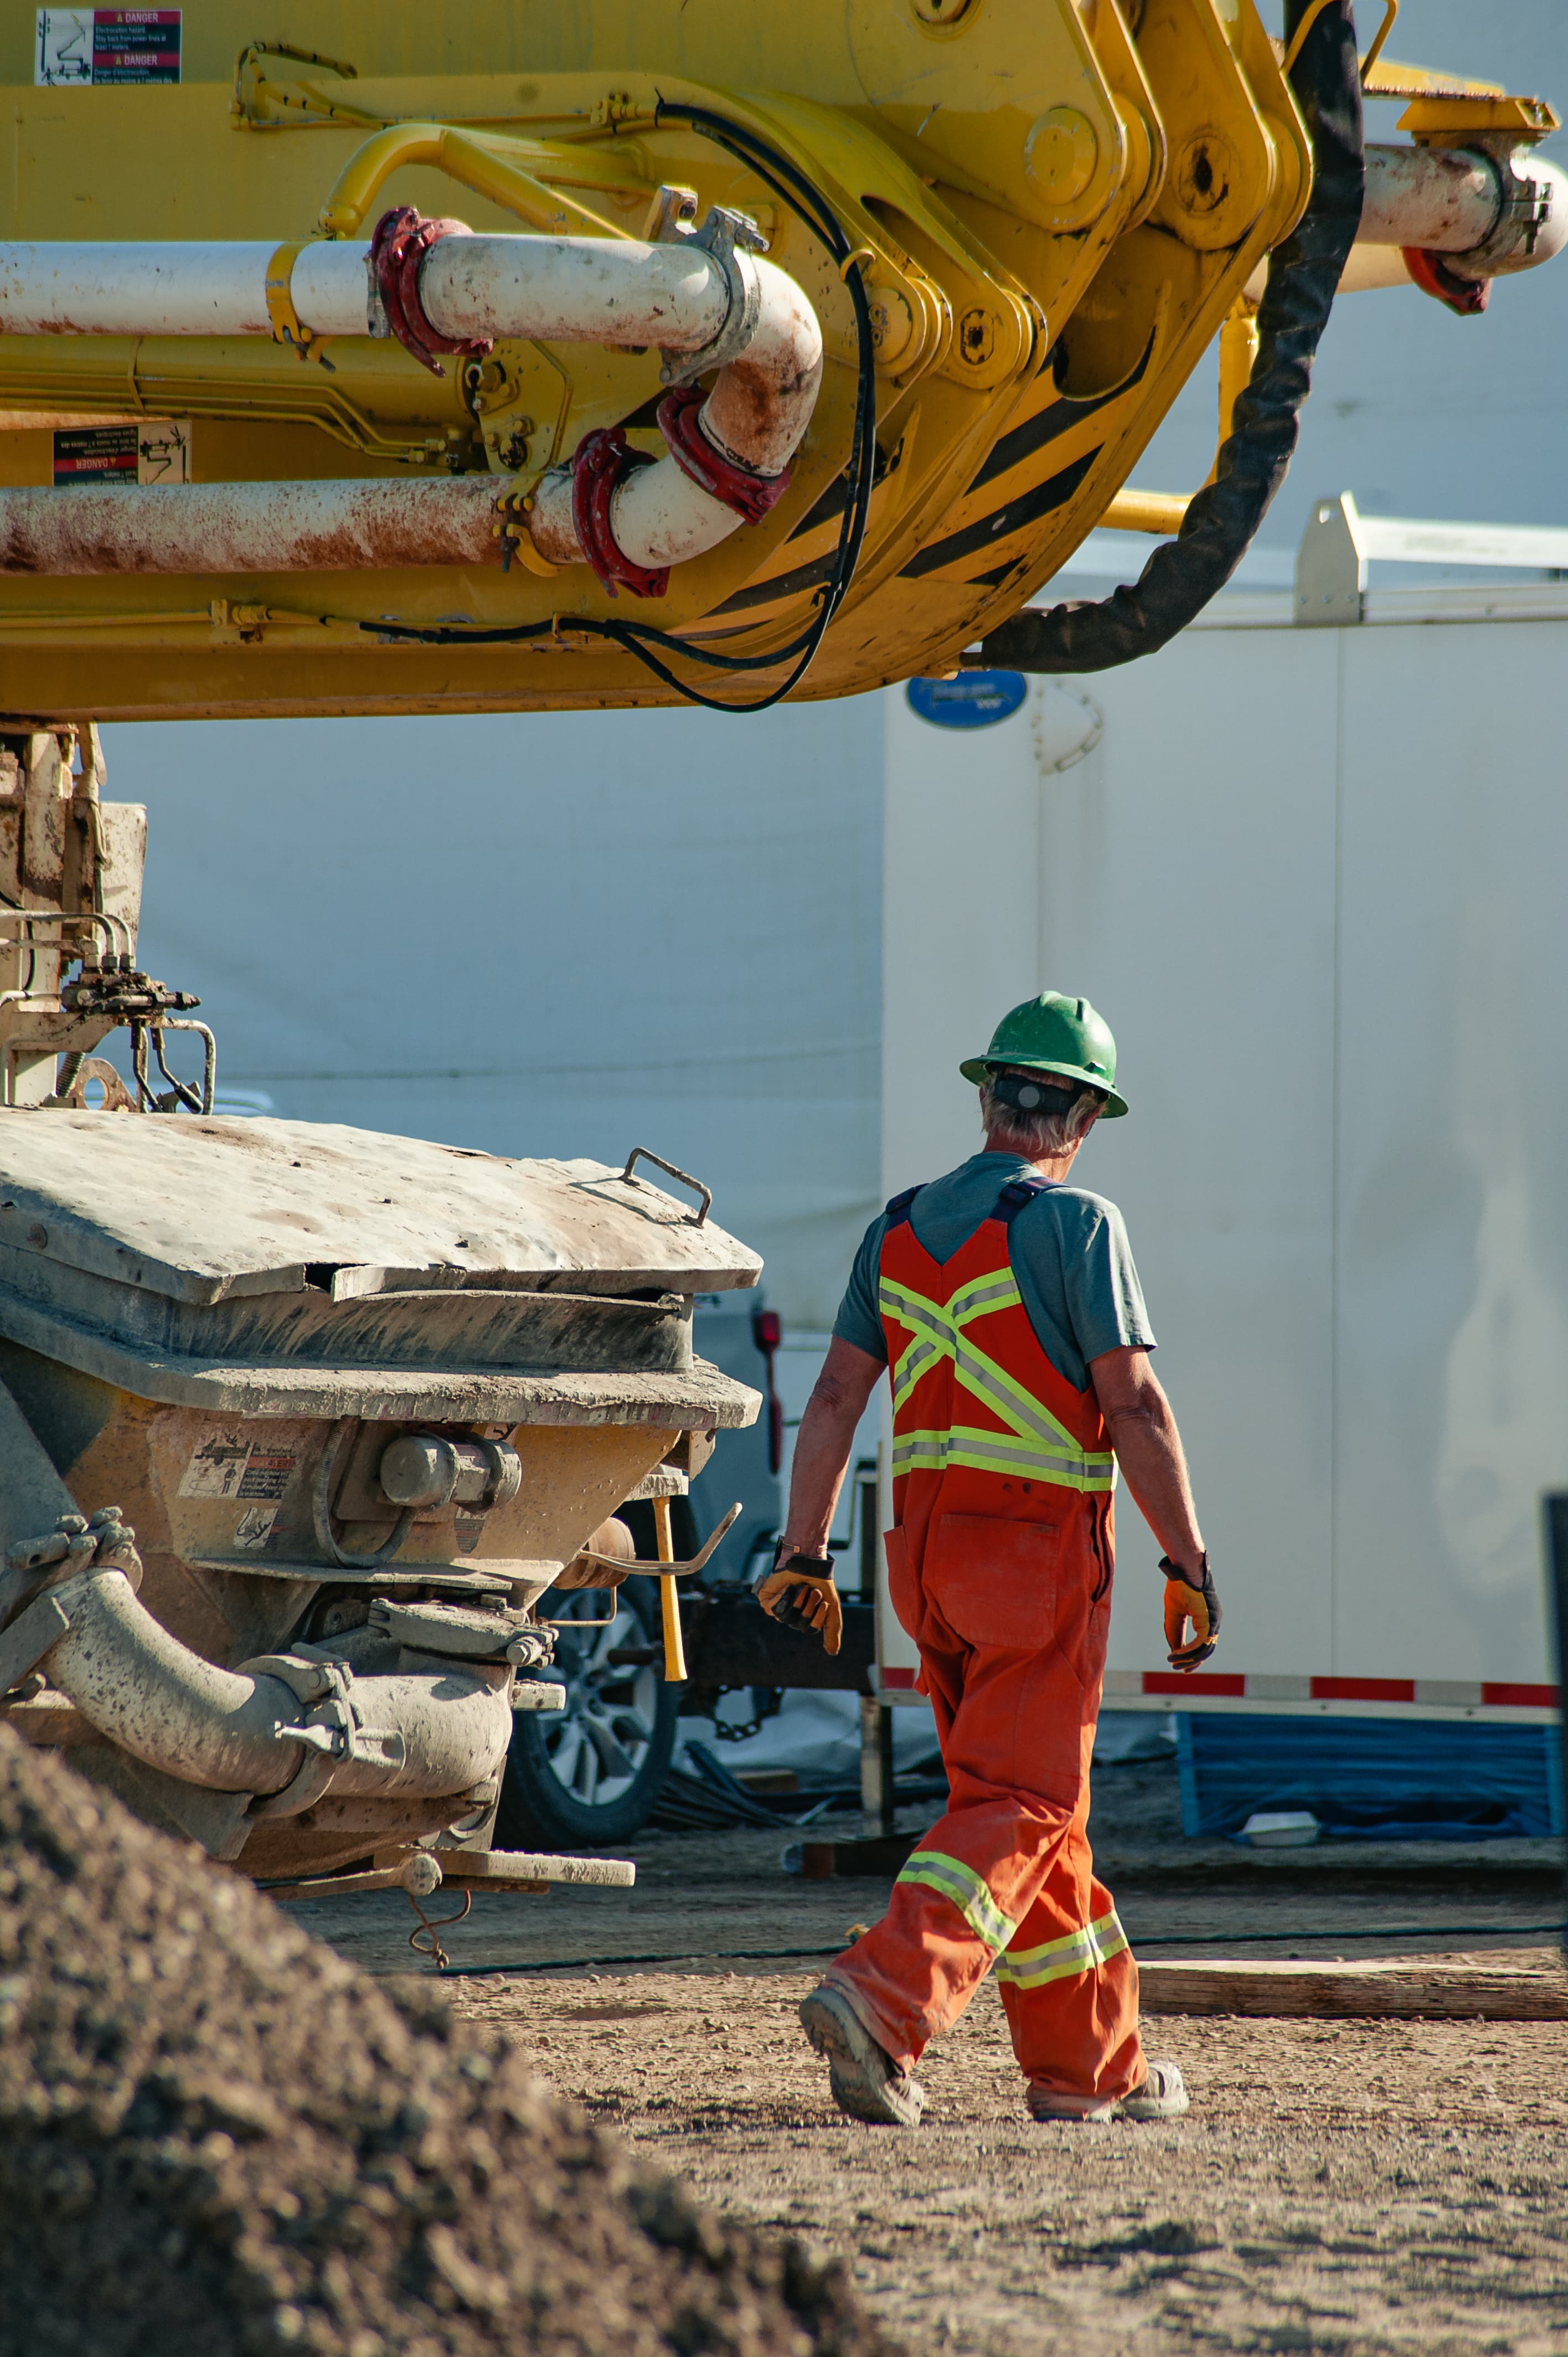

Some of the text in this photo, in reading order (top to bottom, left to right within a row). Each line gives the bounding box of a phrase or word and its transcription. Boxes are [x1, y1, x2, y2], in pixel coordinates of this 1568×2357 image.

[125, 12, 159, 23] DANGER
[95, 34, 106, 43] Stay
[124, 54, 158, 65] DANGER
[76, 458, 108, 470] DANGER
